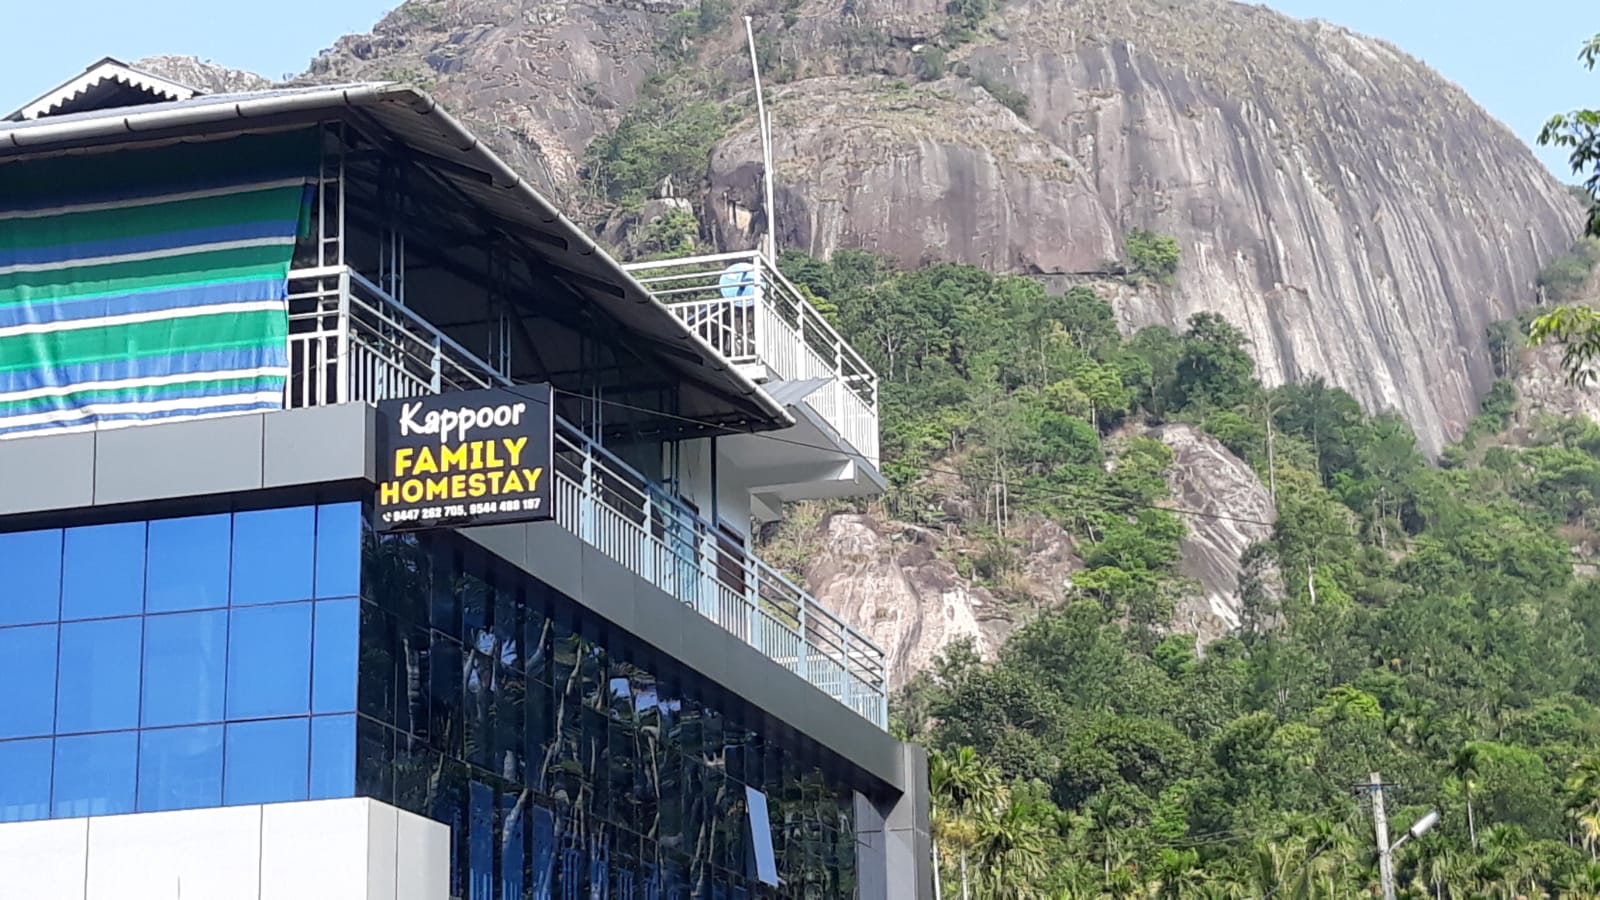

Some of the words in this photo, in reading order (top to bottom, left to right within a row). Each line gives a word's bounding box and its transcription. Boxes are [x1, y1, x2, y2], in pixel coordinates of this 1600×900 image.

[399, 401, 526, 444] Kappoor
[394, 436, 529, 477] FAMILY
[380, 467, 543, 506] HOMESTAY
